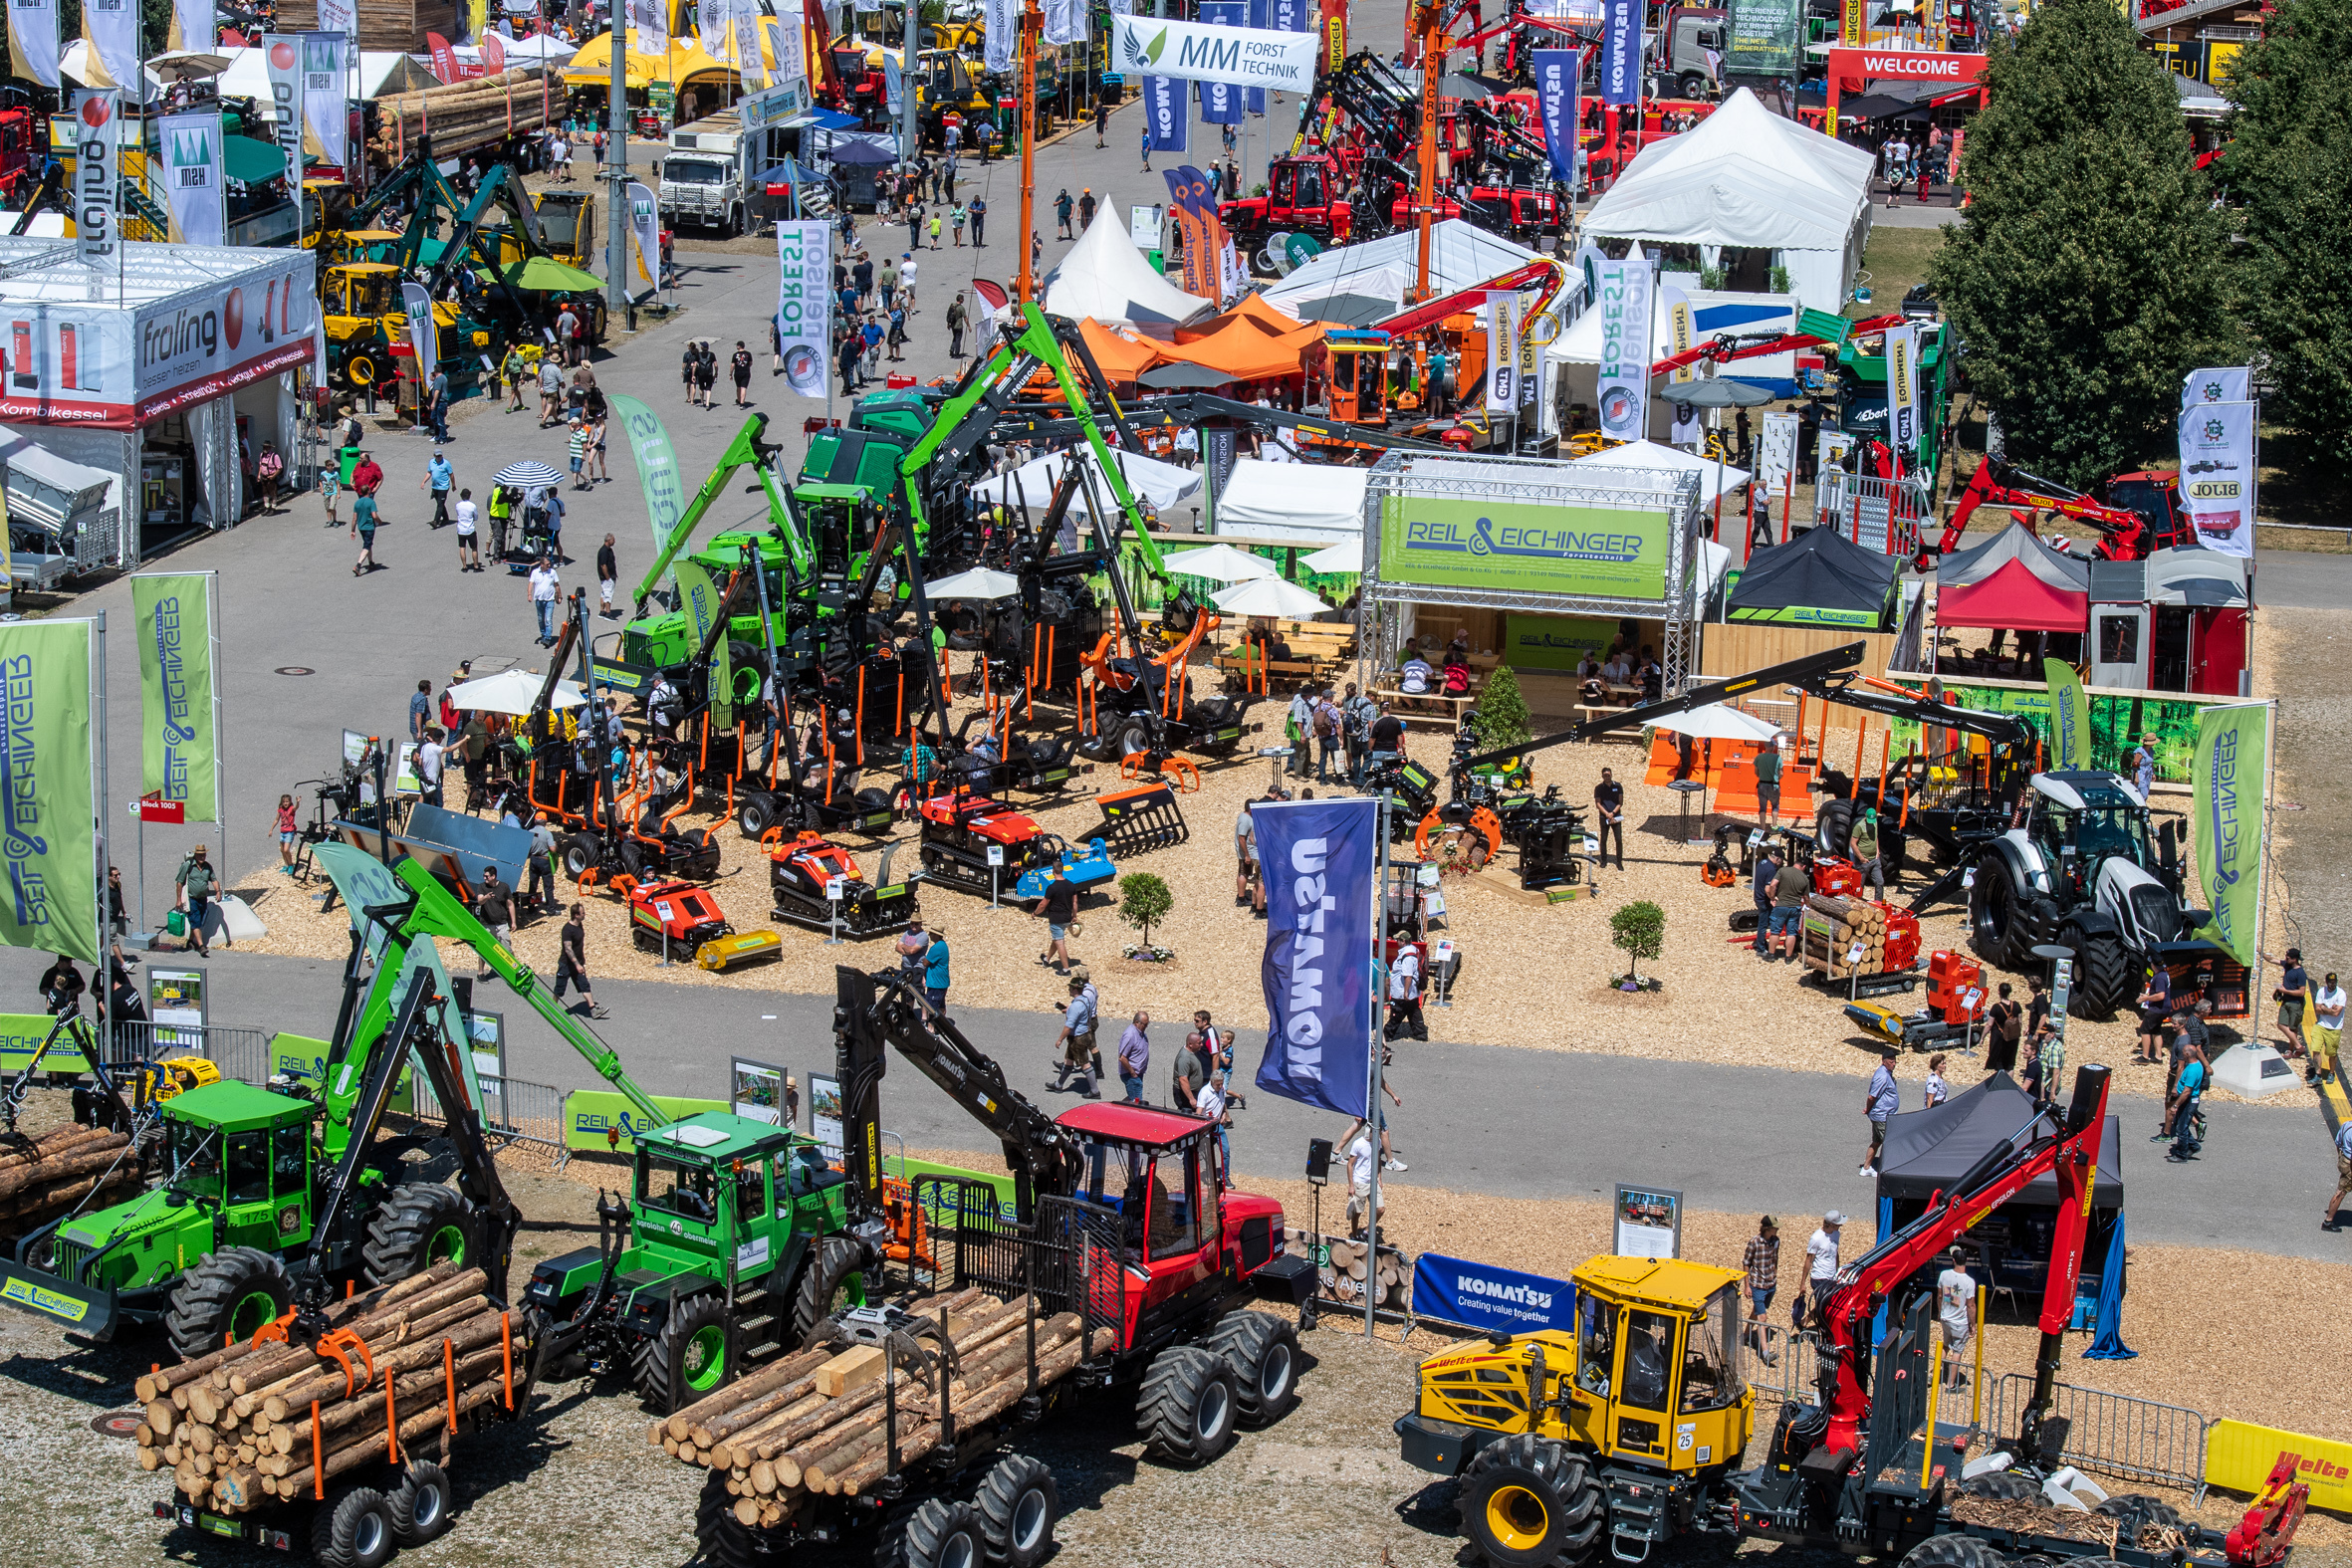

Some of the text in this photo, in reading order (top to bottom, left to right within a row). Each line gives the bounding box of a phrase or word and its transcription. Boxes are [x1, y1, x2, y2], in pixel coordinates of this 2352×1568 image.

[1736, 7, 1782, 16] EXPERIENCE
[1179, 35, 1241, 72] MM
[1245, 42, 1288, 59] FORST
[1734, 44, 1777, 53] GENERATION
[1242, 60, 1299, 79] TECHNIK
[1864, 57, 1959, 76] WELCOME
[1427, 52, 1436, 122] SYNCRO
[172, 359, 201, 381] heizen
[1013, 364, 1038, 395] neuson
[1862, 407, 1888, 422] Ebert
[1103, 420, 1139, 432] neson
[2031, 498, 2052, 507] BIJOL
[1407, 522, 1467, 544] REIL
[1501, 527, 1643, 554] EICHINGER
[1562, 552, 1624, 561] Forsttechnik
[1794, 610, 1813, 619] REIL
[1823, 612, 1868, 624] EICHINGER
[1520, 634, 1542, 645] REIL
[1553, 637, 1604, 649] EICHINGER
[141, 800, 176, 810] Block 1005
[2171, 990, 2204, 1012] UHEIT
[279, 1055, 311, 1069] REIL
[576, 1113, 610, 1128] REIL
[1967, 1187, 2015, 1228] PALFINGER EPSILON
[121, 1216, 164, 1234] EQUUS
[244, 1212, 269, 1224] 175
[636, 1220, 717, 1246] agrolohn 40 obermeier
[9, 1283, 27, 1297] REIL
[38, 1295, 83, 1315] EICHINGER
[1458, 1275, 1552, 1309] KOMATSU
[1458, 1295, 1550, 1324] Creating value together
[1439, 1355, 1473, 1368] Welte
[1680, 1436, 1690, 1447] 25
[2276, 1451, 2350, 1480] Welte
